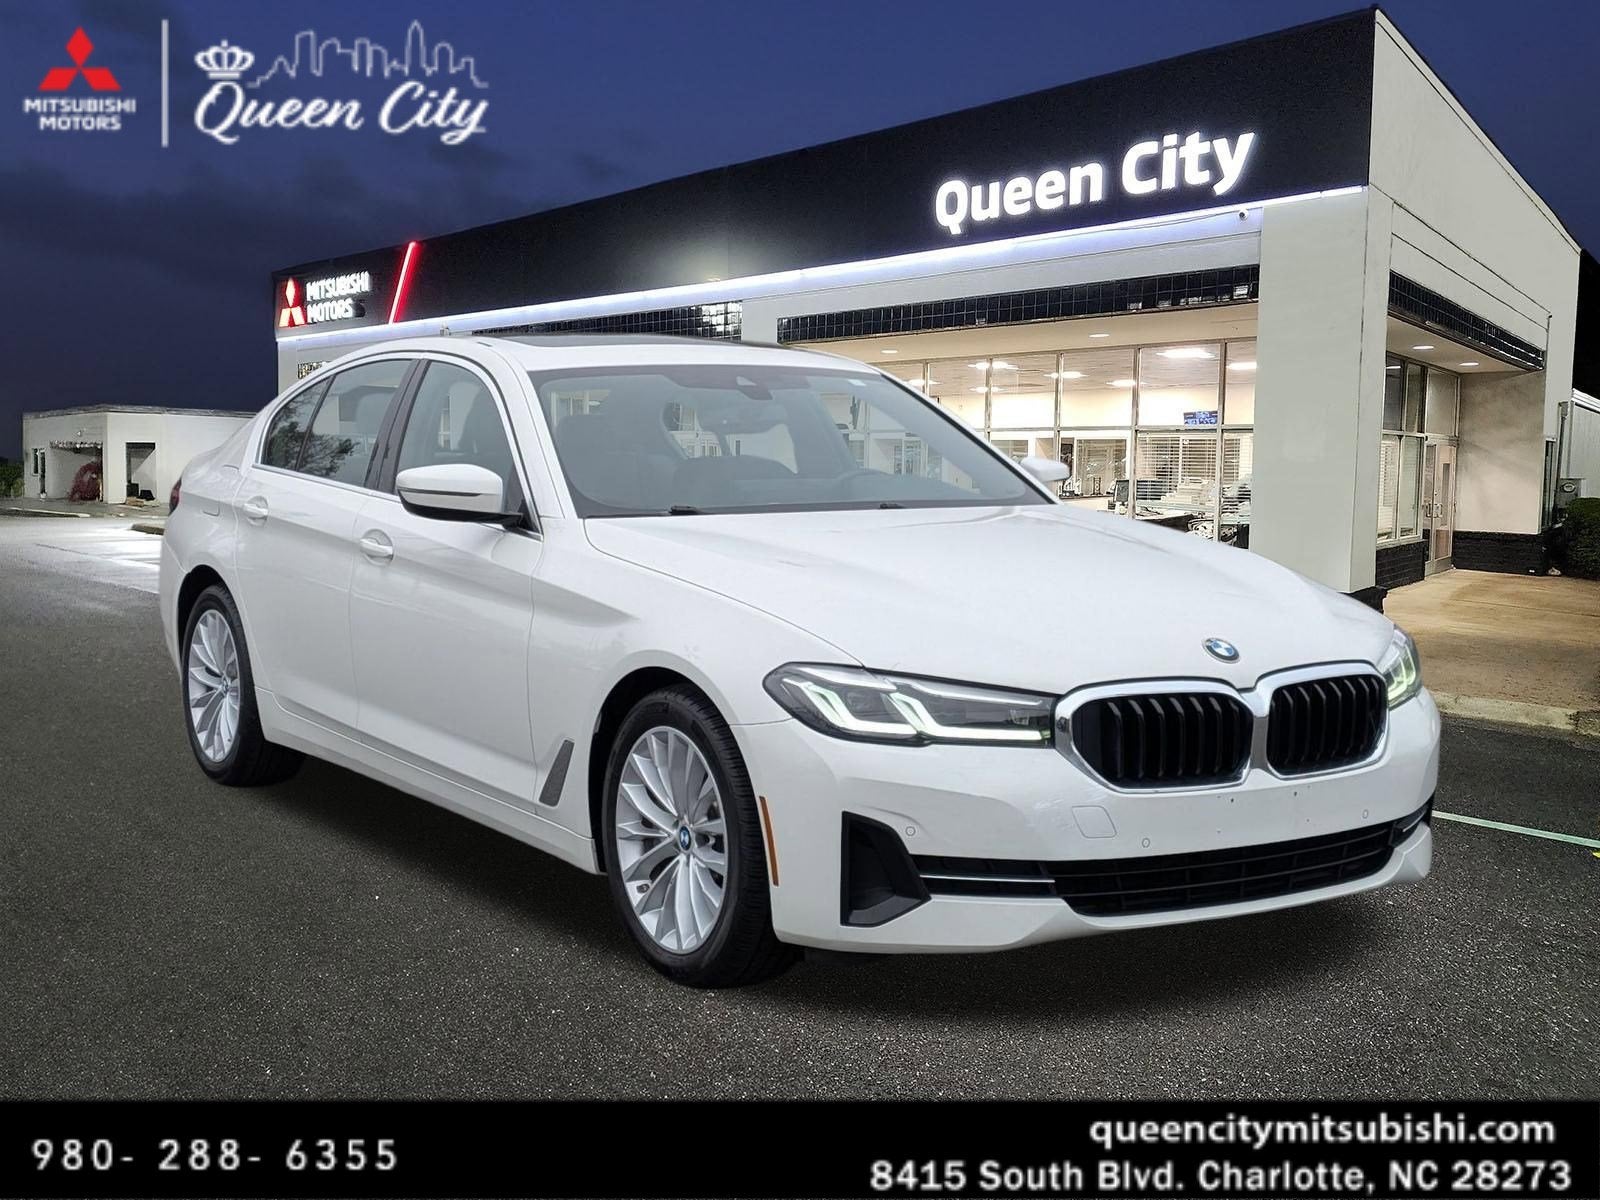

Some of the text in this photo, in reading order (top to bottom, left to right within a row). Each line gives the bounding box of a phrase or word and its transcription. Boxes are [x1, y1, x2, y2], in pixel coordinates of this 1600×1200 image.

[935, 131, 1256, 235] Queen City
[306, 271, 371, 302] MITSUBISHI
[306, 297, 355, 324] MOTORS
